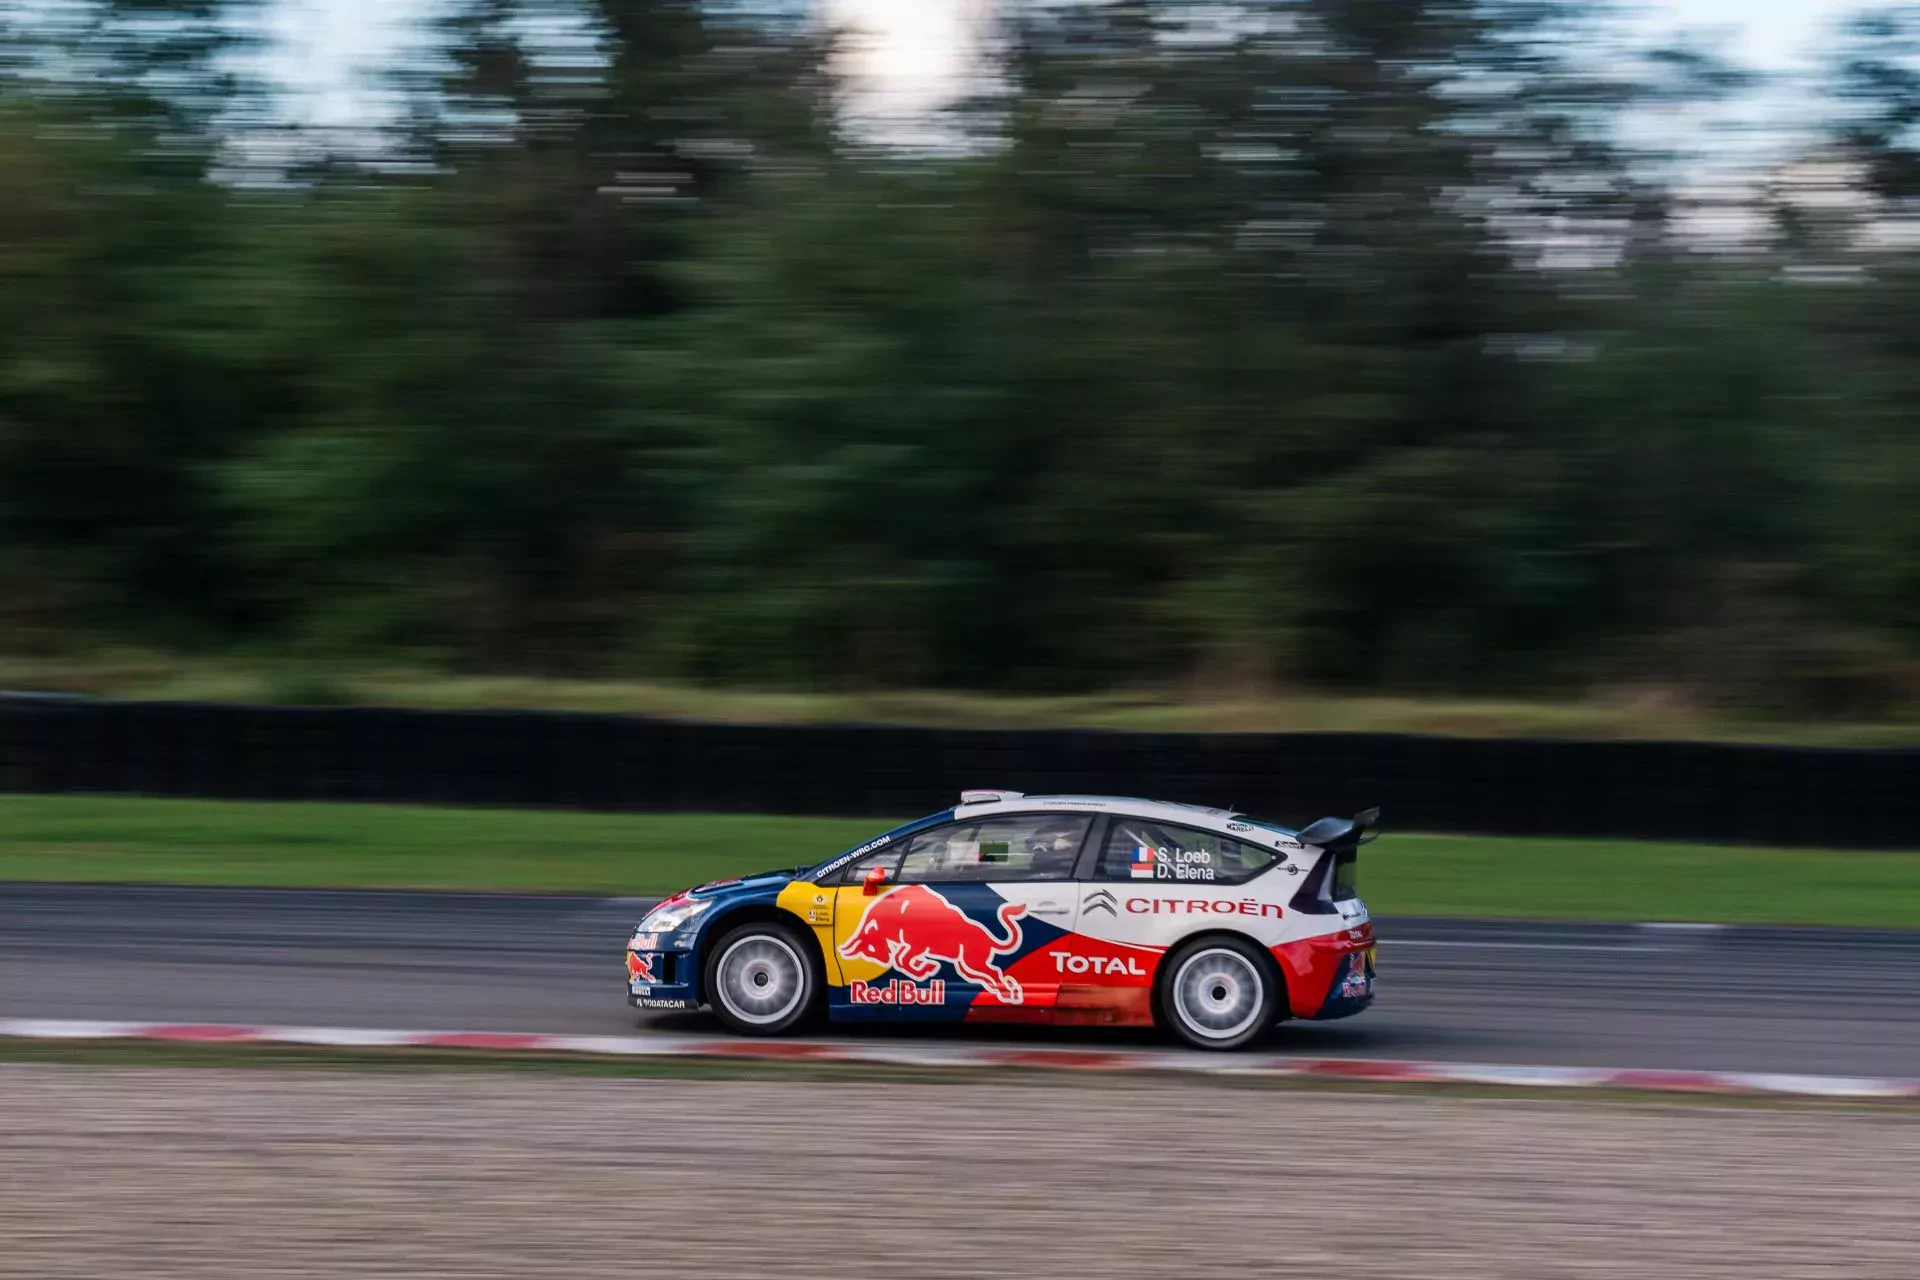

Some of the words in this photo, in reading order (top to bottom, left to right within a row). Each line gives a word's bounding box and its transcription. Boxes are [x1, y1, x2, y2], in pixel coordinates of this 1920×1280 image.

[816, 835, 891, 878] CITROEN-WRC.COM
[1157, 847, 1171, 862] S.
[1176, 848, 1211, 864] Loeb
[1157, 863, 1172, 879] D.
[1176, 864, 1215, 880] Elena
[1125, 898, 1284, 919] CITROËN
[1049, 951, 1147, 975] TOTAL
[851, 979, 897, 1004] Red
[899, 979, 945, 1005] Bull
